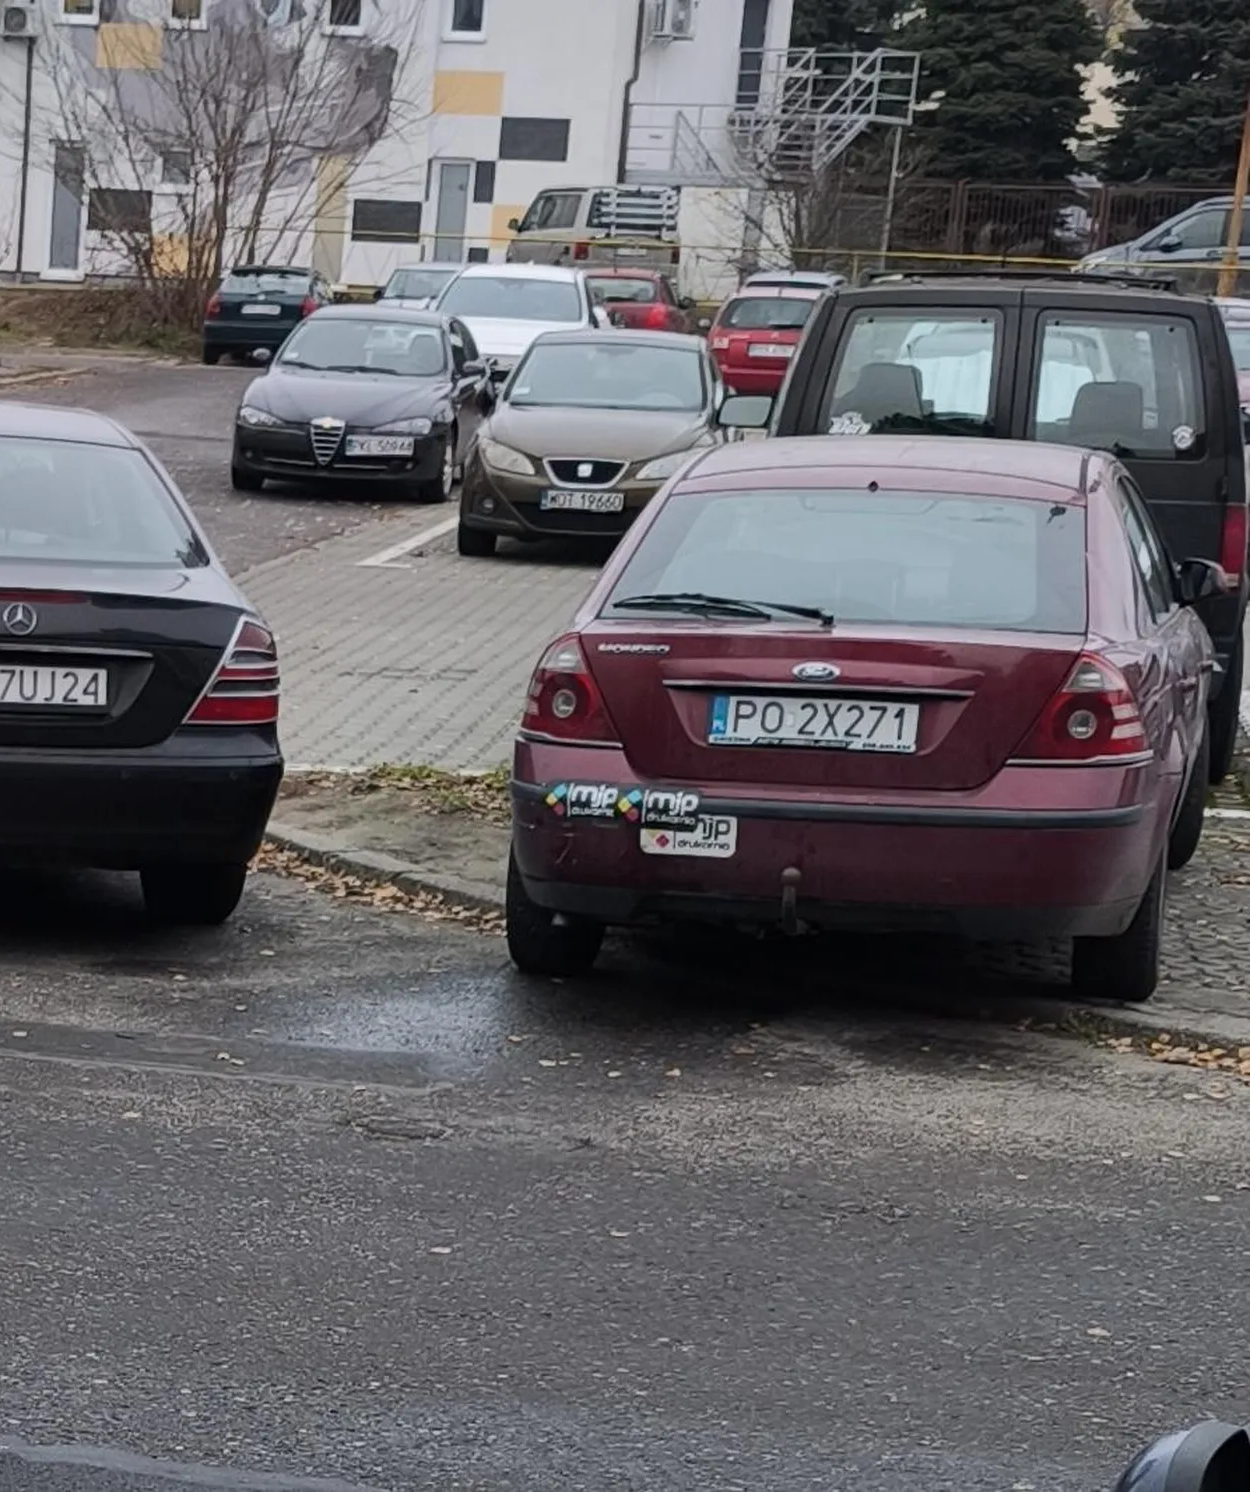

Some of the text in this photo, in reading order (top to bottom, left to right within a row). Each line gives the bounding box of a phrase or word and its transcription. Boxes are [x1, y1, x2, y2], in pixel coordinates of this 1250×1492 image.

[579, 494, 623, 511] 19660
[733, 700, 907, 741] PO 2X271
[571, 784, 619, 809] mjp
[647, 790, 699, 816] mjp
